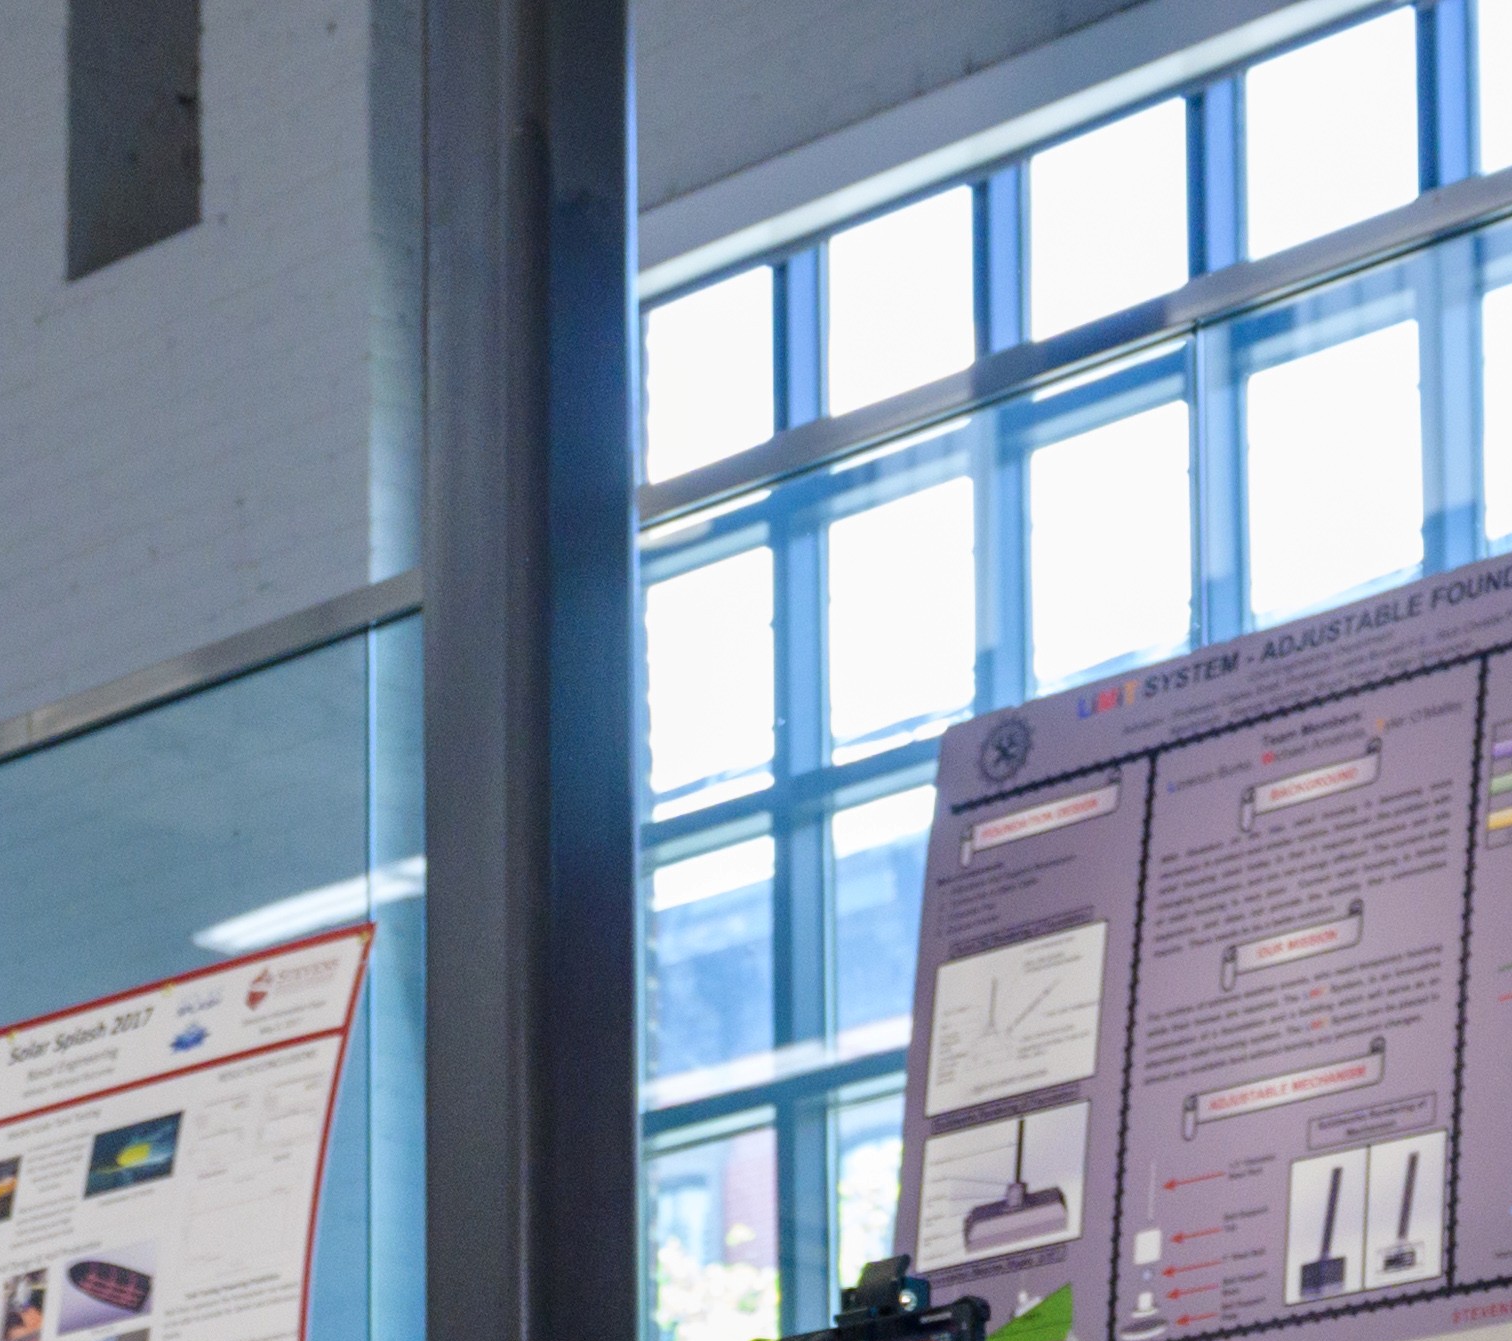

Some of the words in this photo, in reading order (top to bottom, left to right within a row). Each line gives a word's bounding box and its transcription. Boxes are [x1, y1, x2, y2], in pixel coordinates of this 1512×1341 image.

[1144, 652, 1240, 698] SYSTEM
[1261, 593, 1422, 661] ADJUSTABLE
[8, 1041, 51, 1067] Solar
[54, 1021, 107, 1053] Splash
[111, 1006, 155, 1035] 2017
